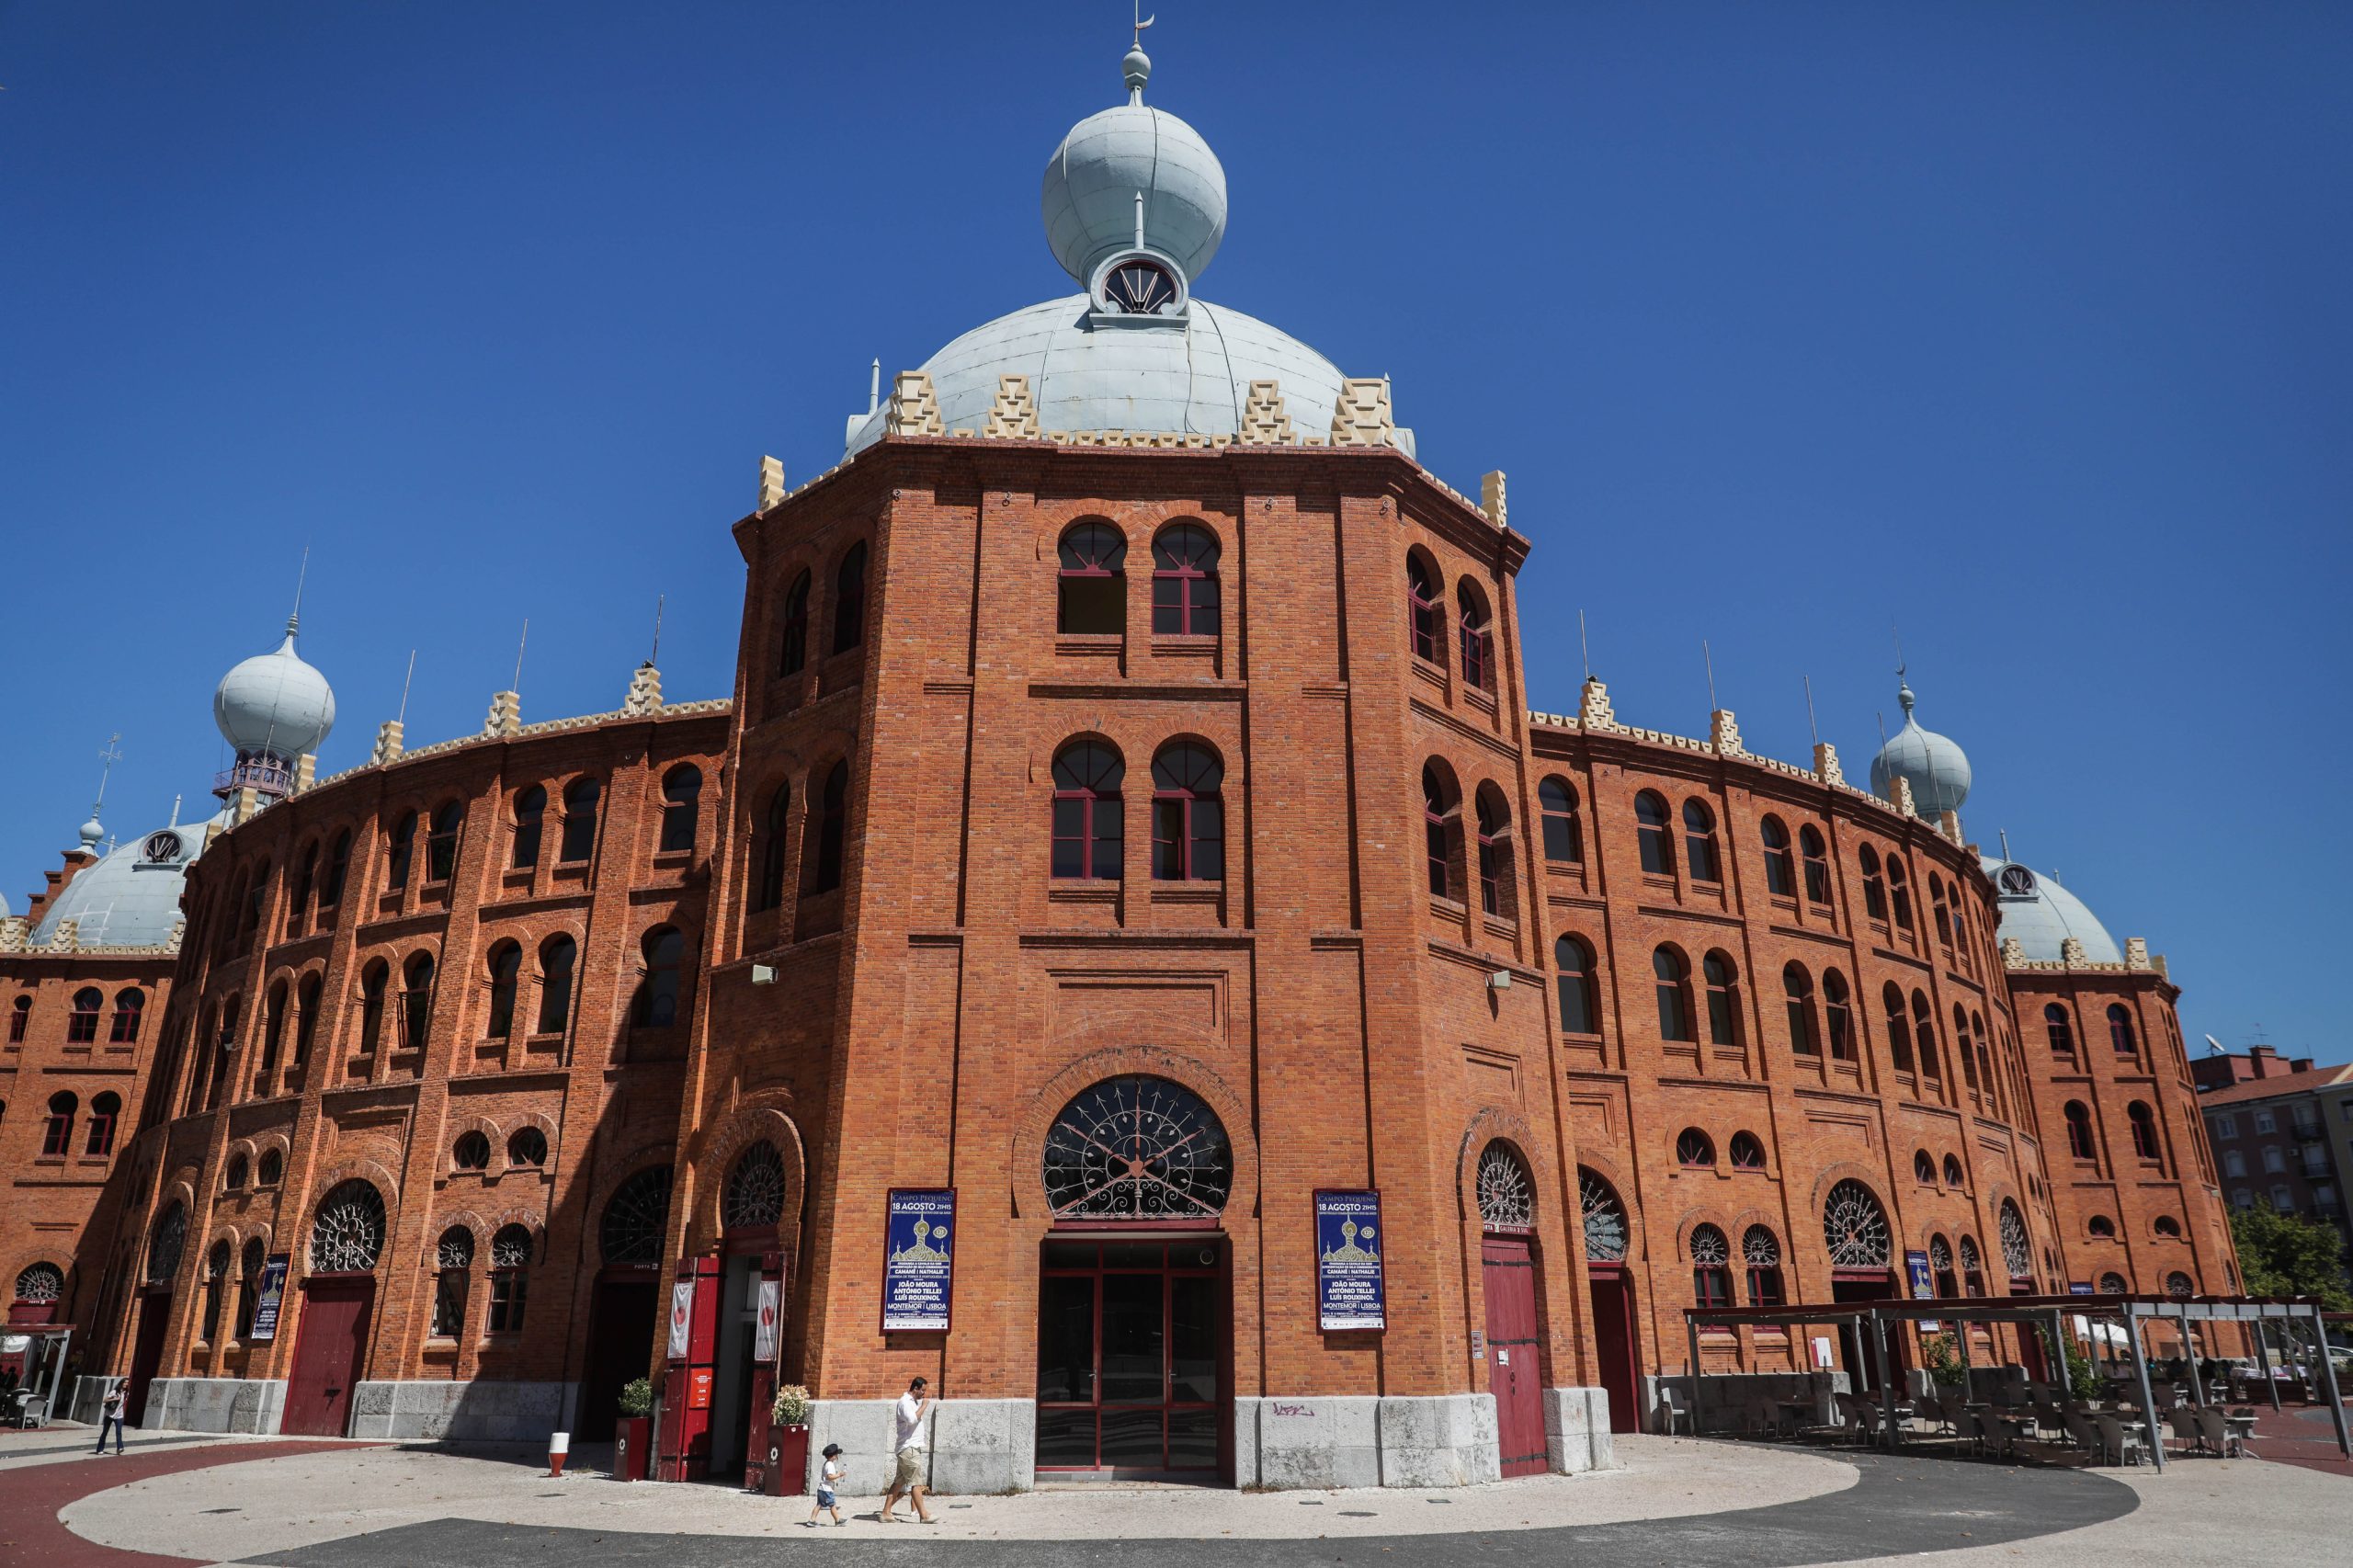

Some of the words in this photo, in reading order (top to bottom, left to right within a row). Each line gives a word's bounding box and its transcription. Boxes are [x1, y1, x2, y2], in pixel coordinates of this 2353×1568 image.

[892, 1202, 901, 1210] 18
[902, 1202, 936, 1210] AGOSTO
[1319, 1203, 1326, 1211] 18
[1327, 1203, 1361, 1211] AGOSTO
